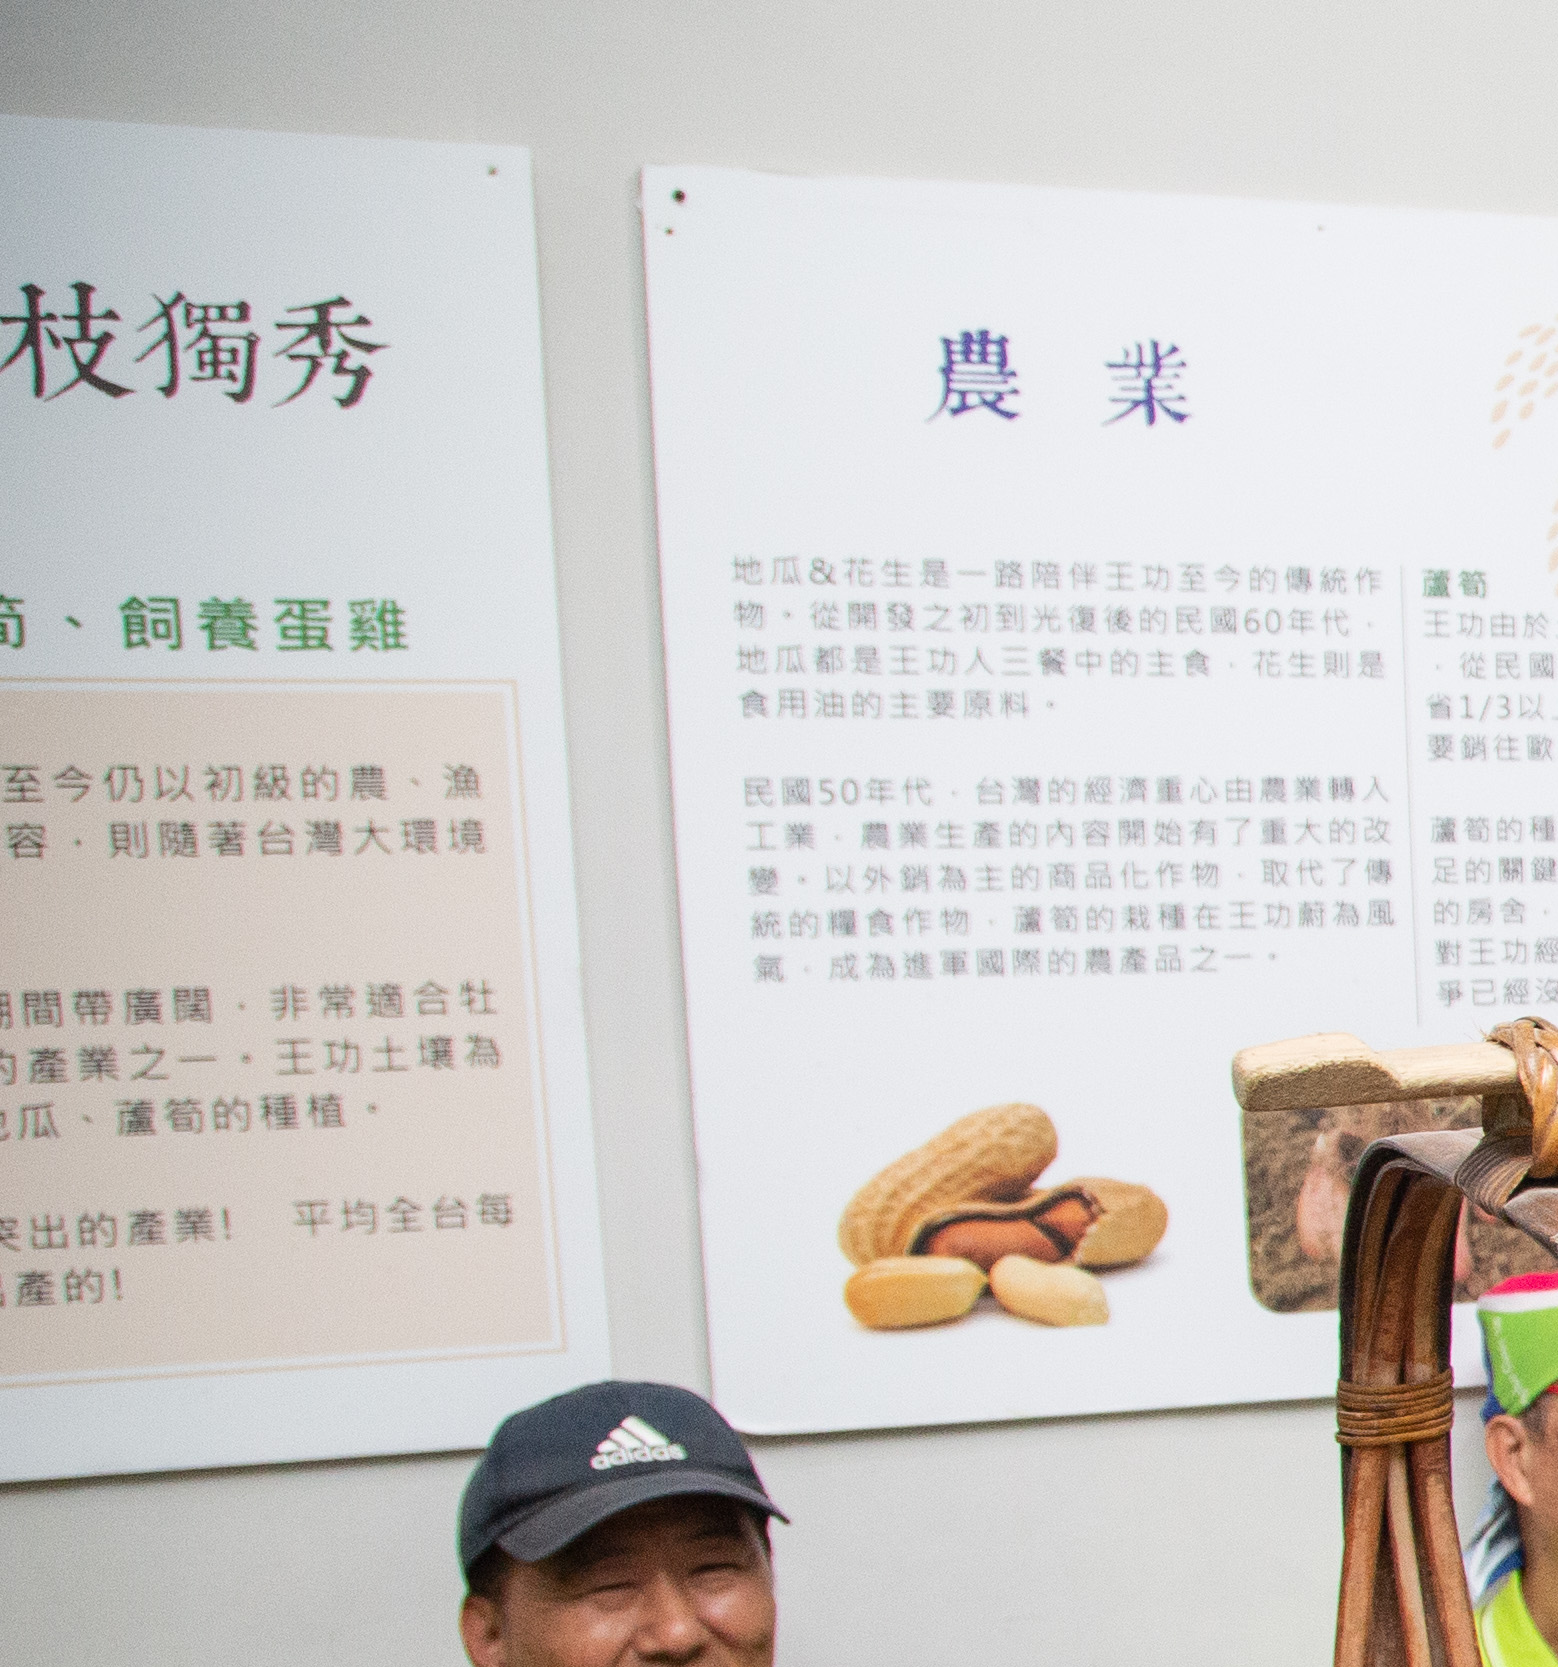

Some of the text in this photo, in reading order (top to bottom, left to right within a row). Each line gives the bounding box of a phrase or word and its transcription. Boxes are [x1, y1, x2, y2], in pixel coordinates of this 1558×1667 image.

[0, 280, 390, 410] 枝獨秀
[929, 327, 1191, 427] 農業
[1423, 569, 1487, 598] 蘆筍
[0, 1092, 377, 1142] 瓜、蘆筍的種植。
[590, 1443, 688, 1470] adidas
